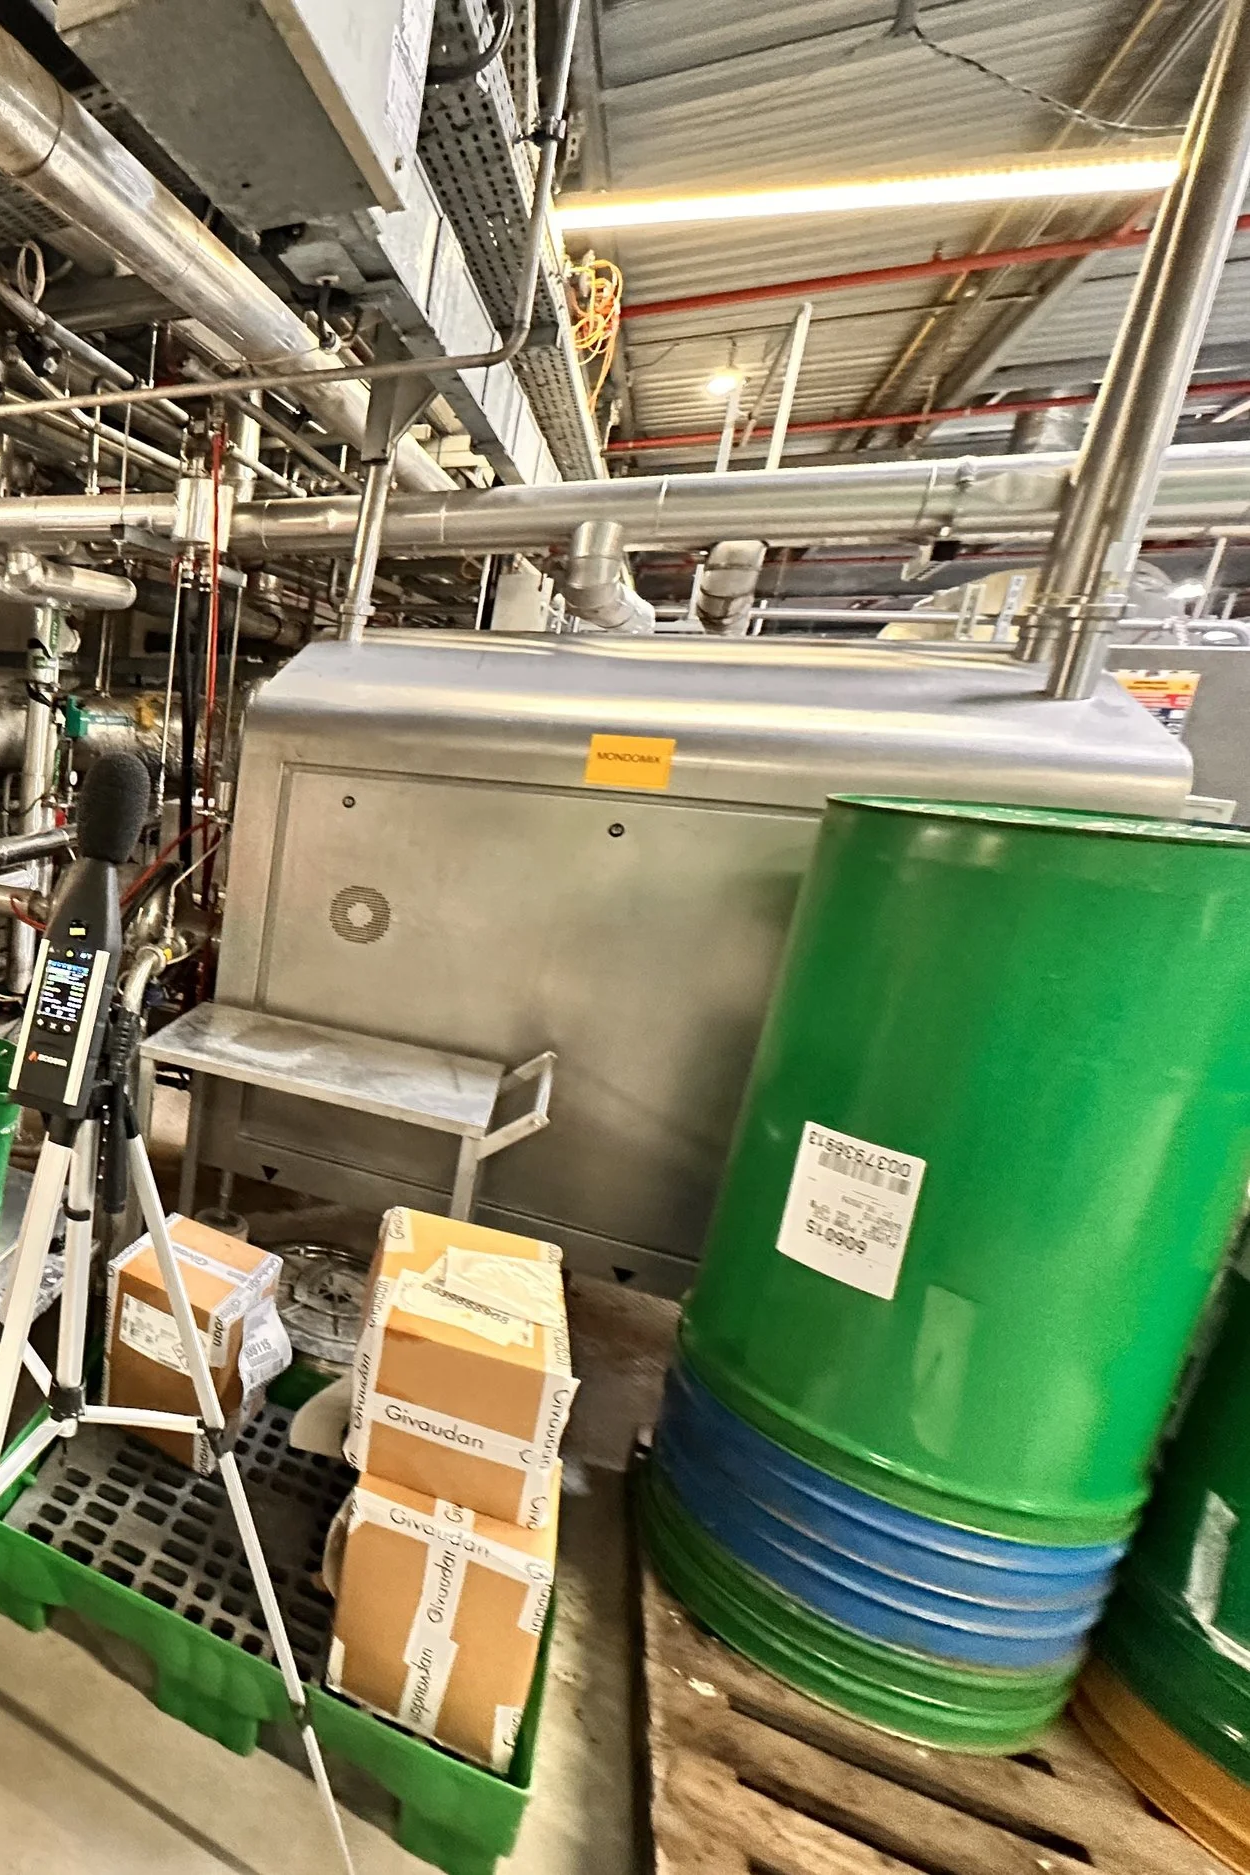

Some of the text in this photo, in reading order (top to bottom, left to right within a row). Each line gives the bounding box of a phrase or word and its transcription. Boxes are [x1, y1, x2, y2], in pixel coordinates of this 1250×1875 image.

[596, 752, 661, 764] MONDOMIX
[806, 1219, 867, 1255] 606015
[385, 1404, 485, 1449] Givaudan
[389, 1507, 496, 1558] Givaudan
